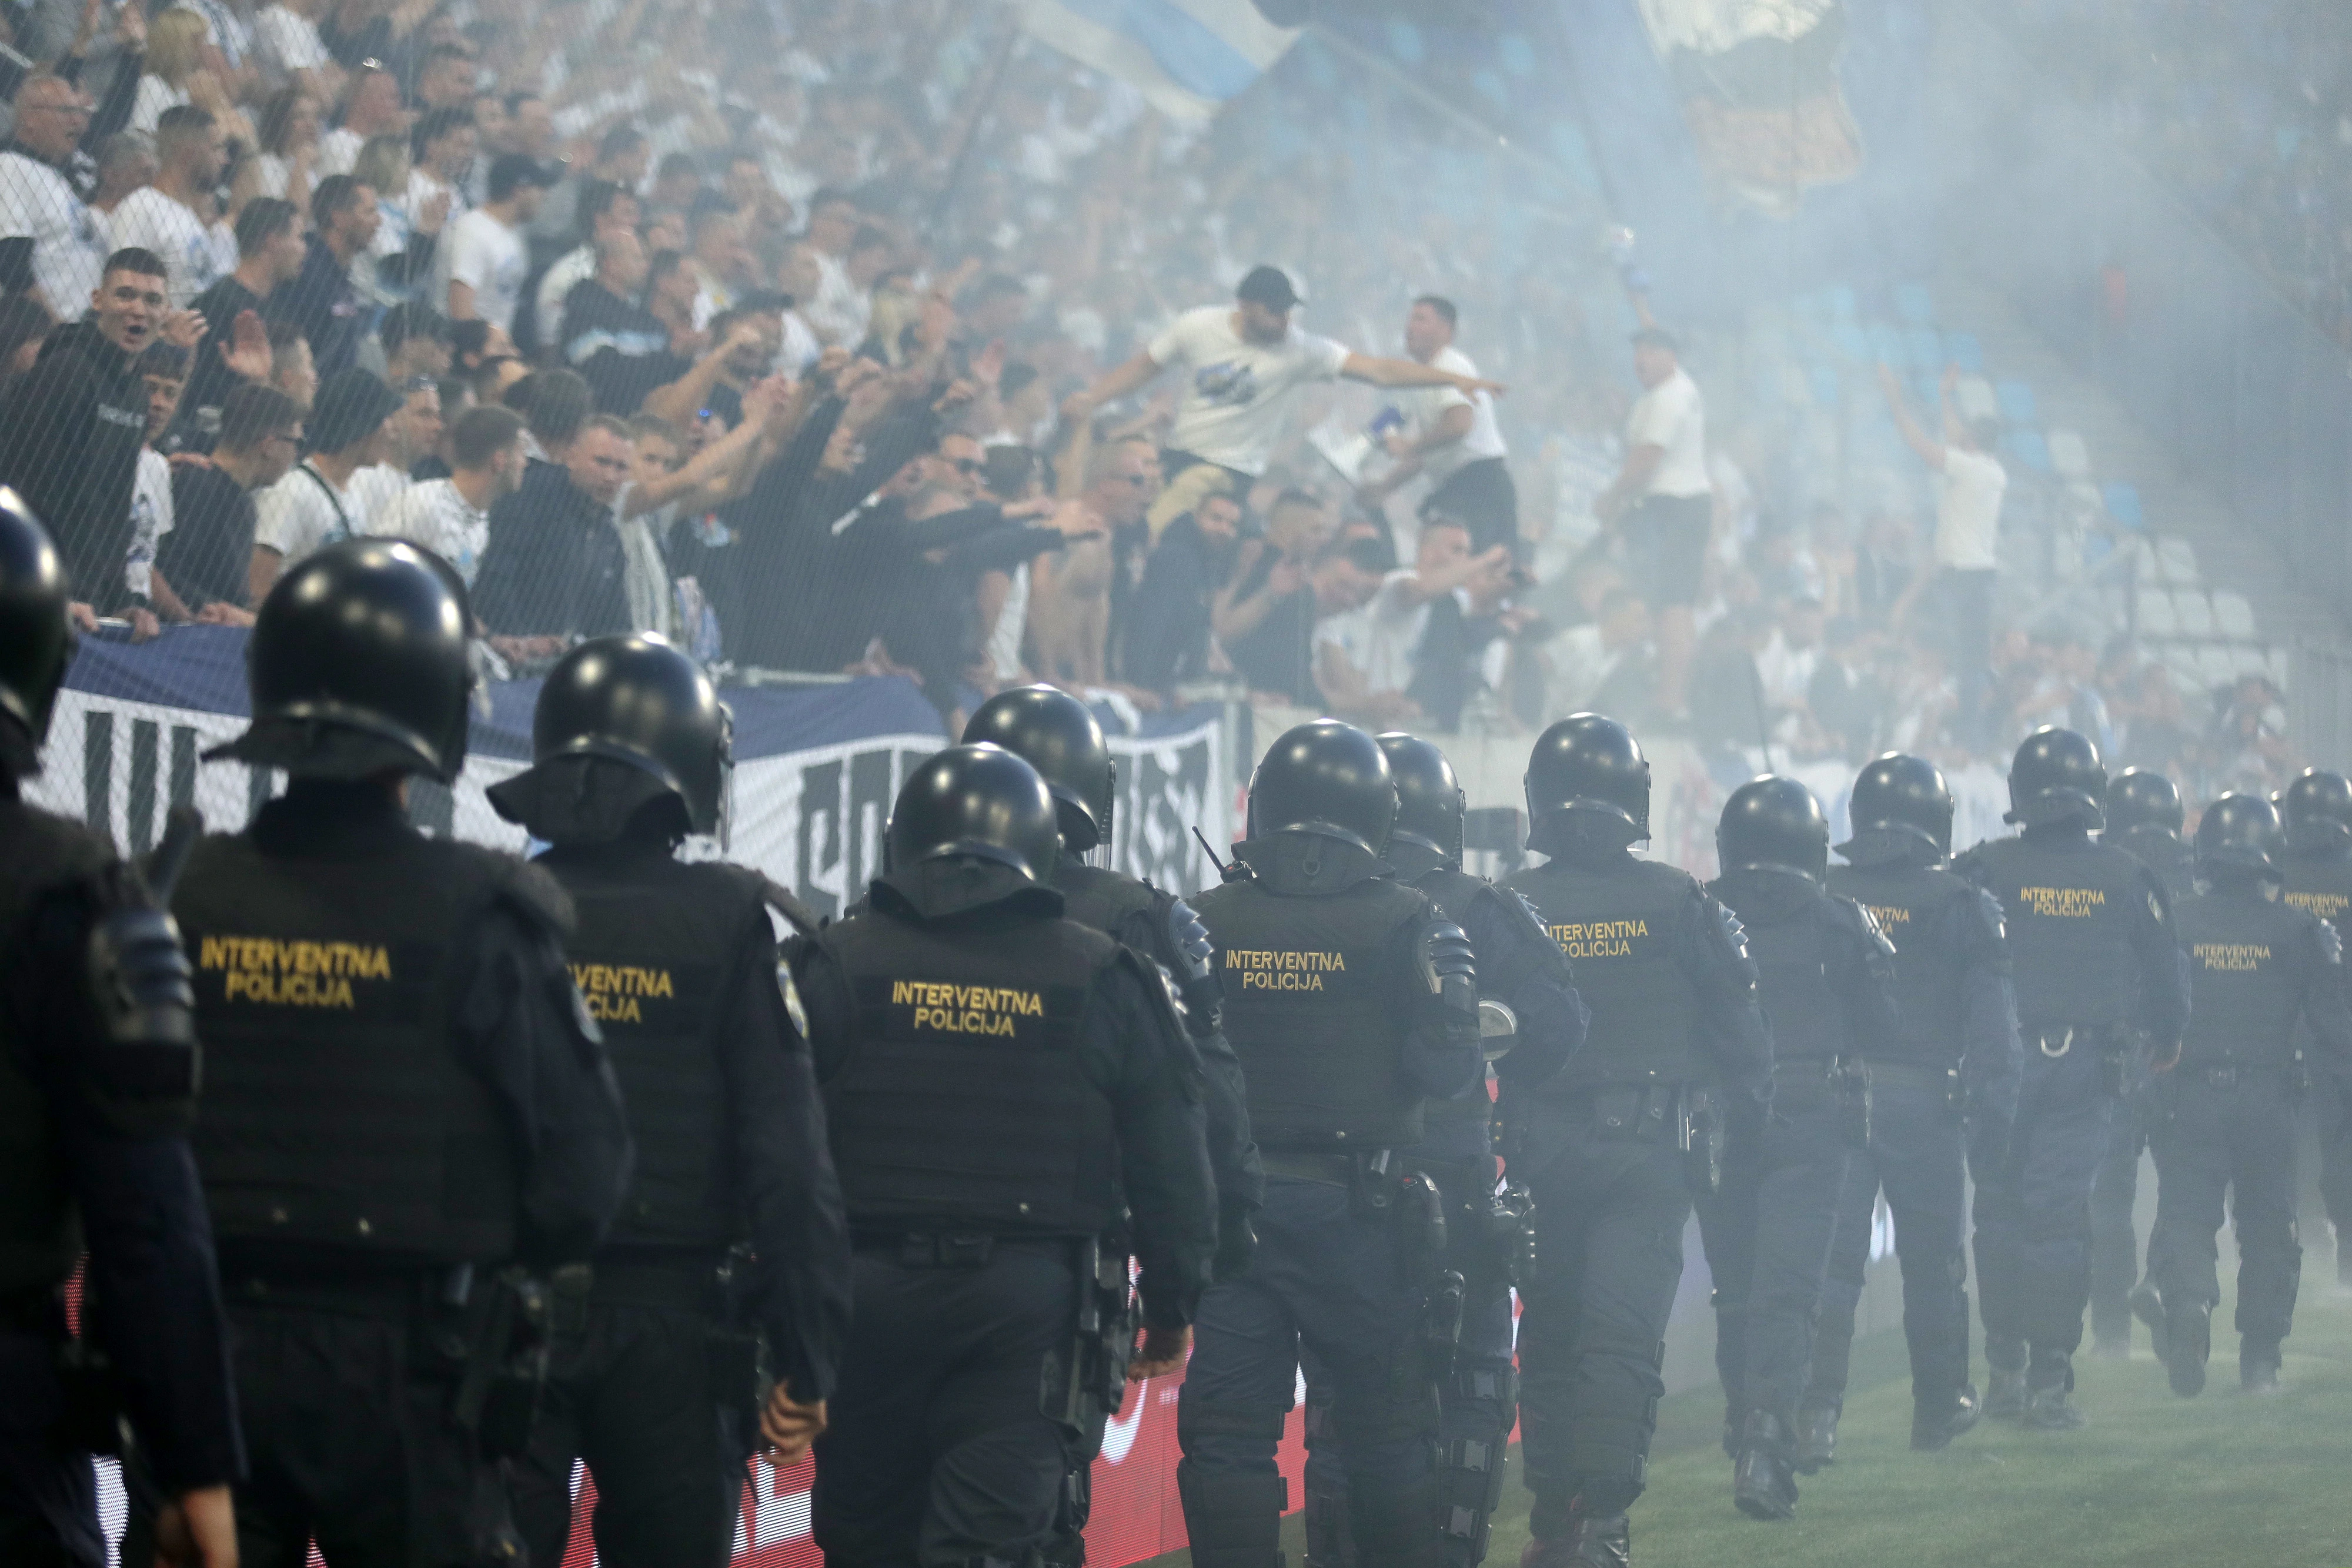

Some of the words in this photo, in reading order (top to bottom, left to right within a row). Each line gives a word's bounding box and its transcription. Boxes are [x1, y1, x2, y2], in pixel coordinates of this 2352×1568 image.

[2020, 887, 2106, 905] INTERVENTNA
[2034, 901, 2091, 918] POLICIJA
[201, 937, 390, 978] INTERVENTNA
[1225, 950, 1345, 971] INTERVENTNA
[2193, 943, 2271, 959] INTERVENTNA
[2205, 957, 2257, 971] POLICIJA
[226, 971, 354, 1007] POLICIJA
[566, 963, 673, 998] VENTNA
[1242, 972, 1324, 991] POLICIJA
[892, 981, 1043, 1016] INTERVENTNA
[914, 1007, 1015, 1037] POLICIJA
